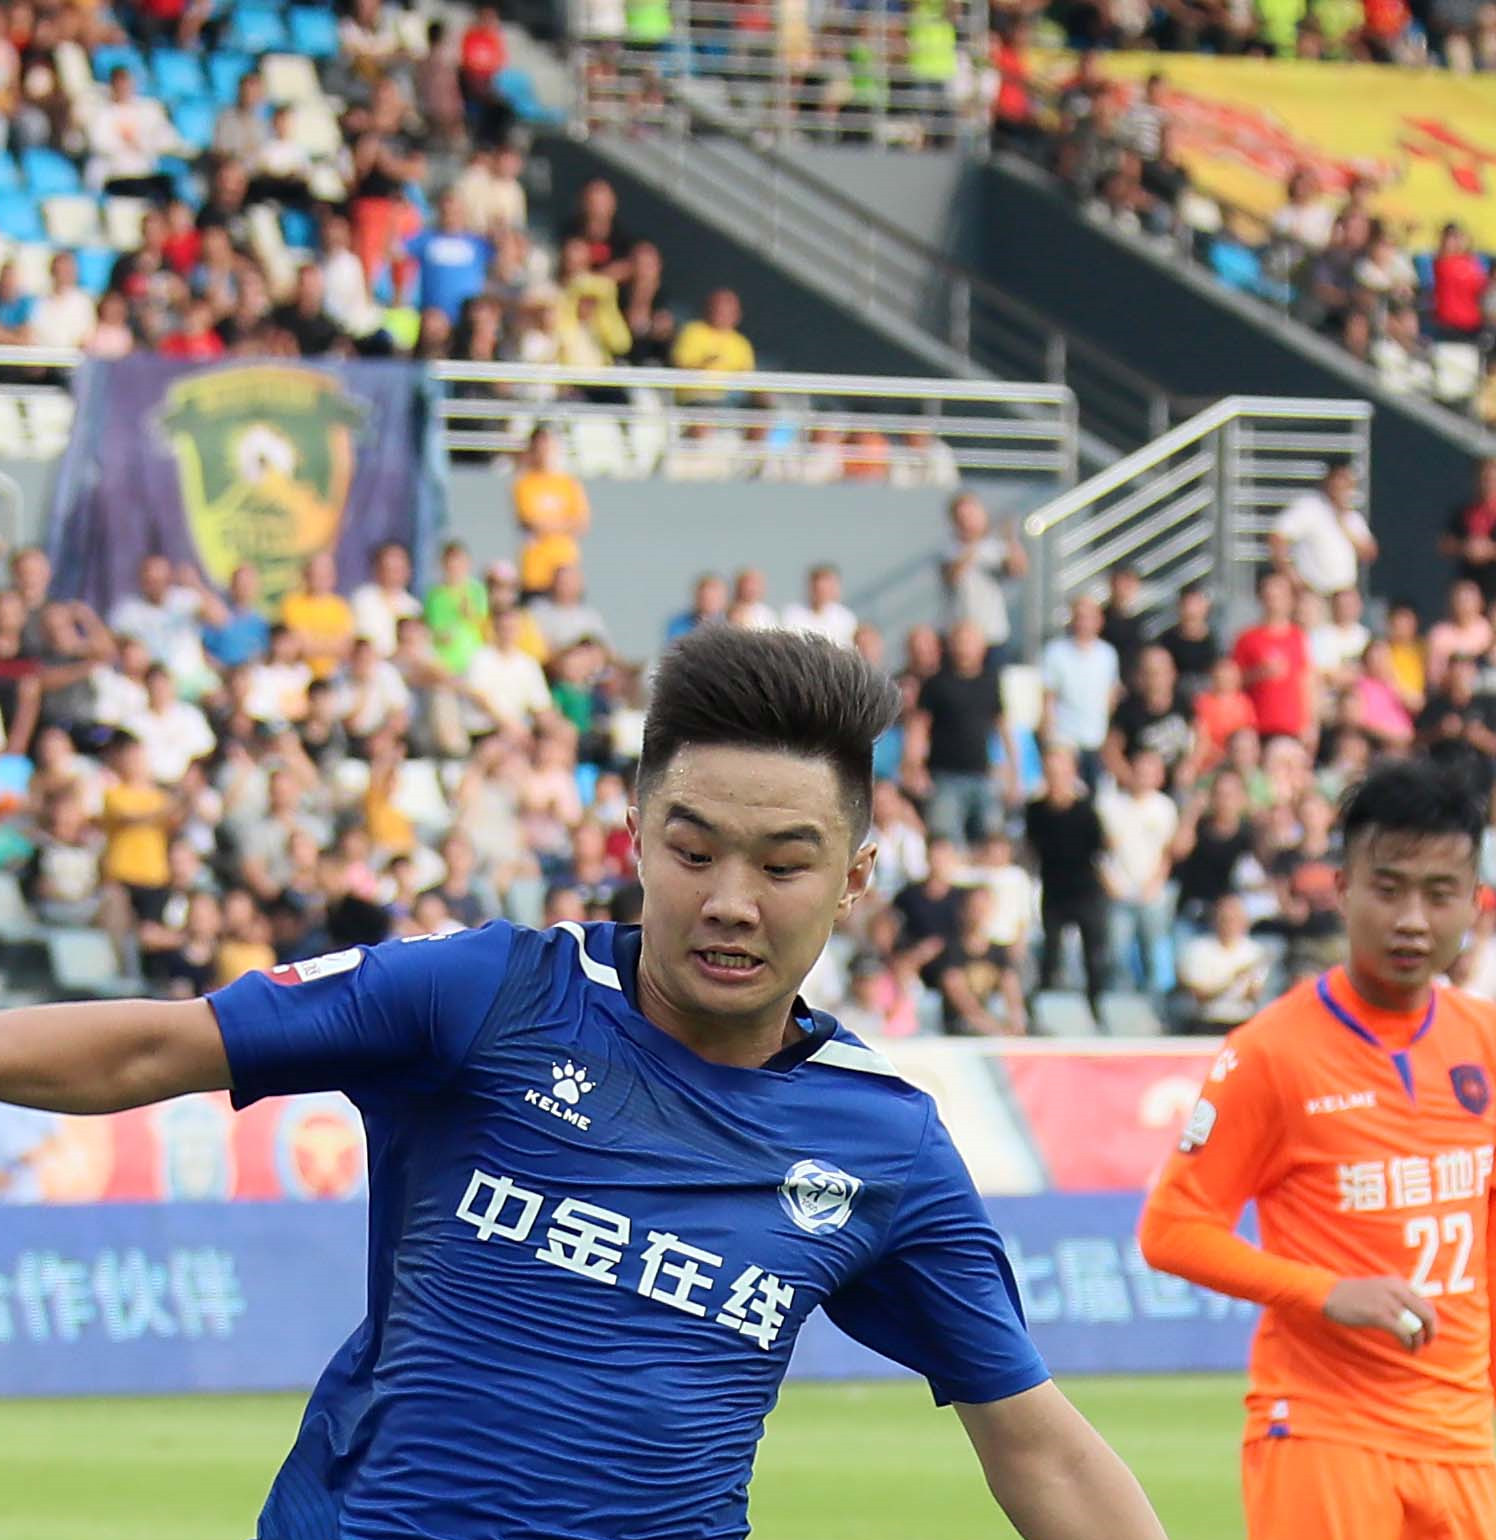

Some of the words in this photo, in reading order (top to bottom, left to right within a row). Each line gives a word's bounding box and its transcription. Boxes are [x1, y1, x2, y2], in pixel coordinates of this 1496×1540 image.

[524, 1088, 592, 1132] KELME
[455, 1168, 796, 1351] 中金在线
[1403, 1211, 1476, 1299] 22
